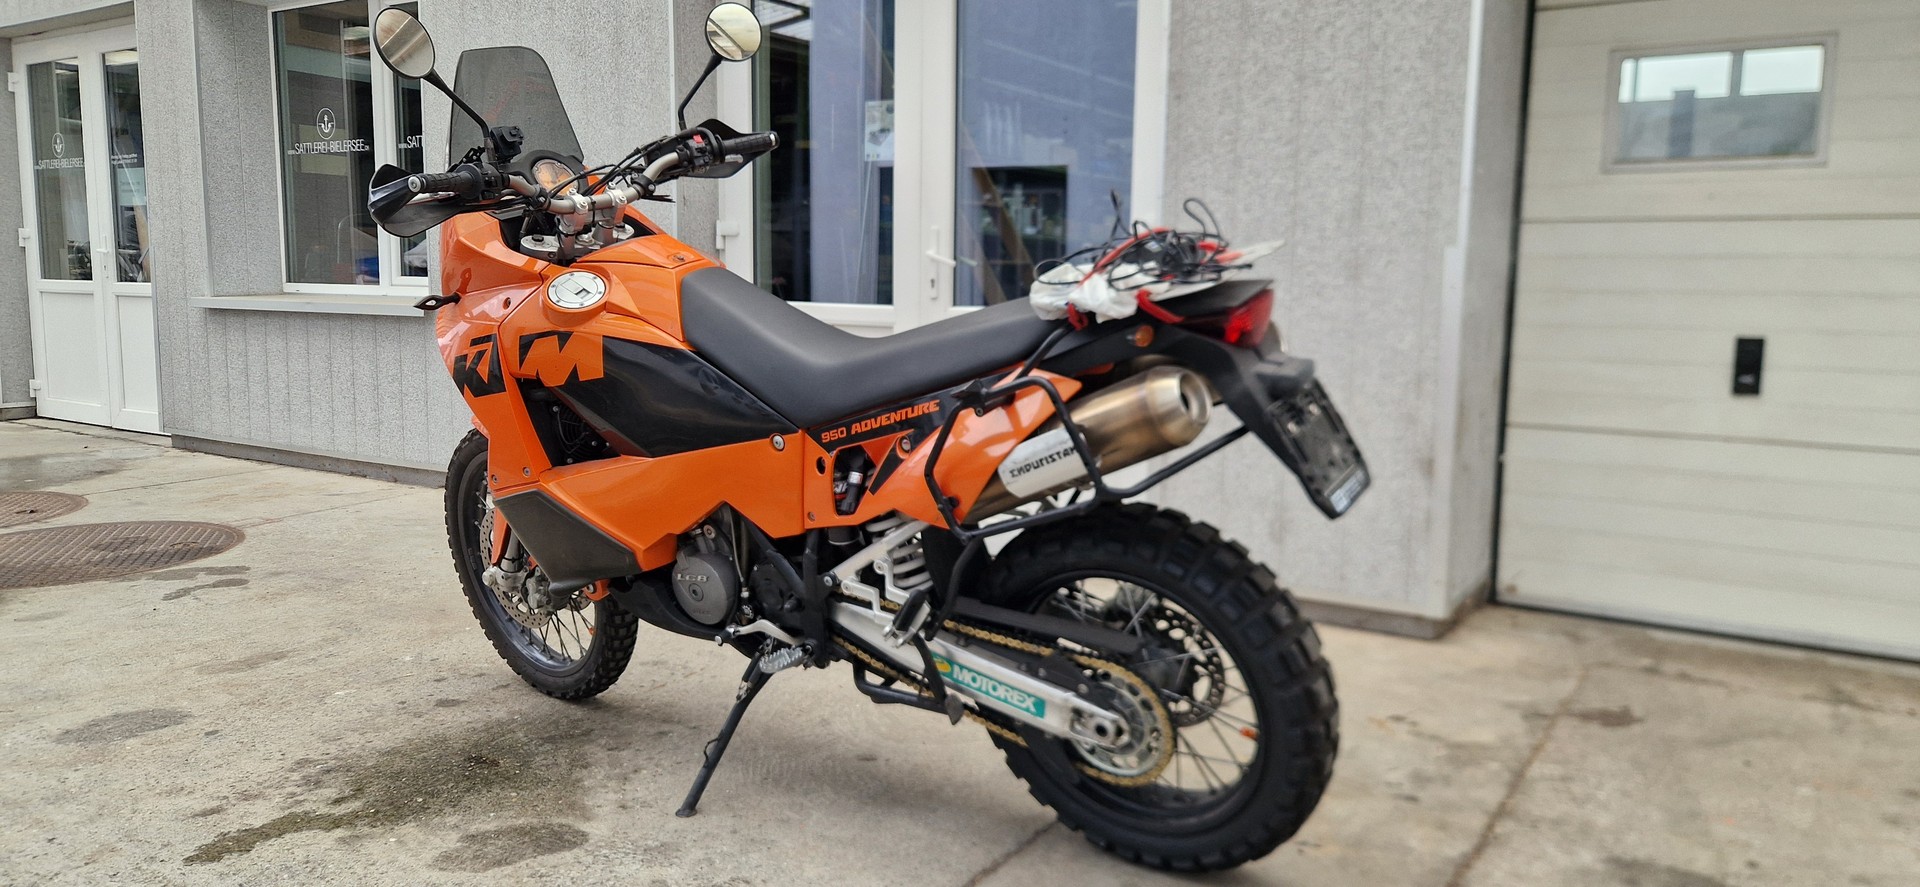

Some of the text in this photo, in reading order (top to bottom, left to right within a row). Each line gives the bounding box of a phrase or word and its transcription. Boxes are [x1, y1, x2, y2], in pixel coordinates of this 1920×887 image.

[453, 330, 604, 398] KTM
[821, 399, 940, 443] 950 ADVENTURE
[677, 573, 707, 582] LC8
[952, 664, 1037, 713] MOTOREX
